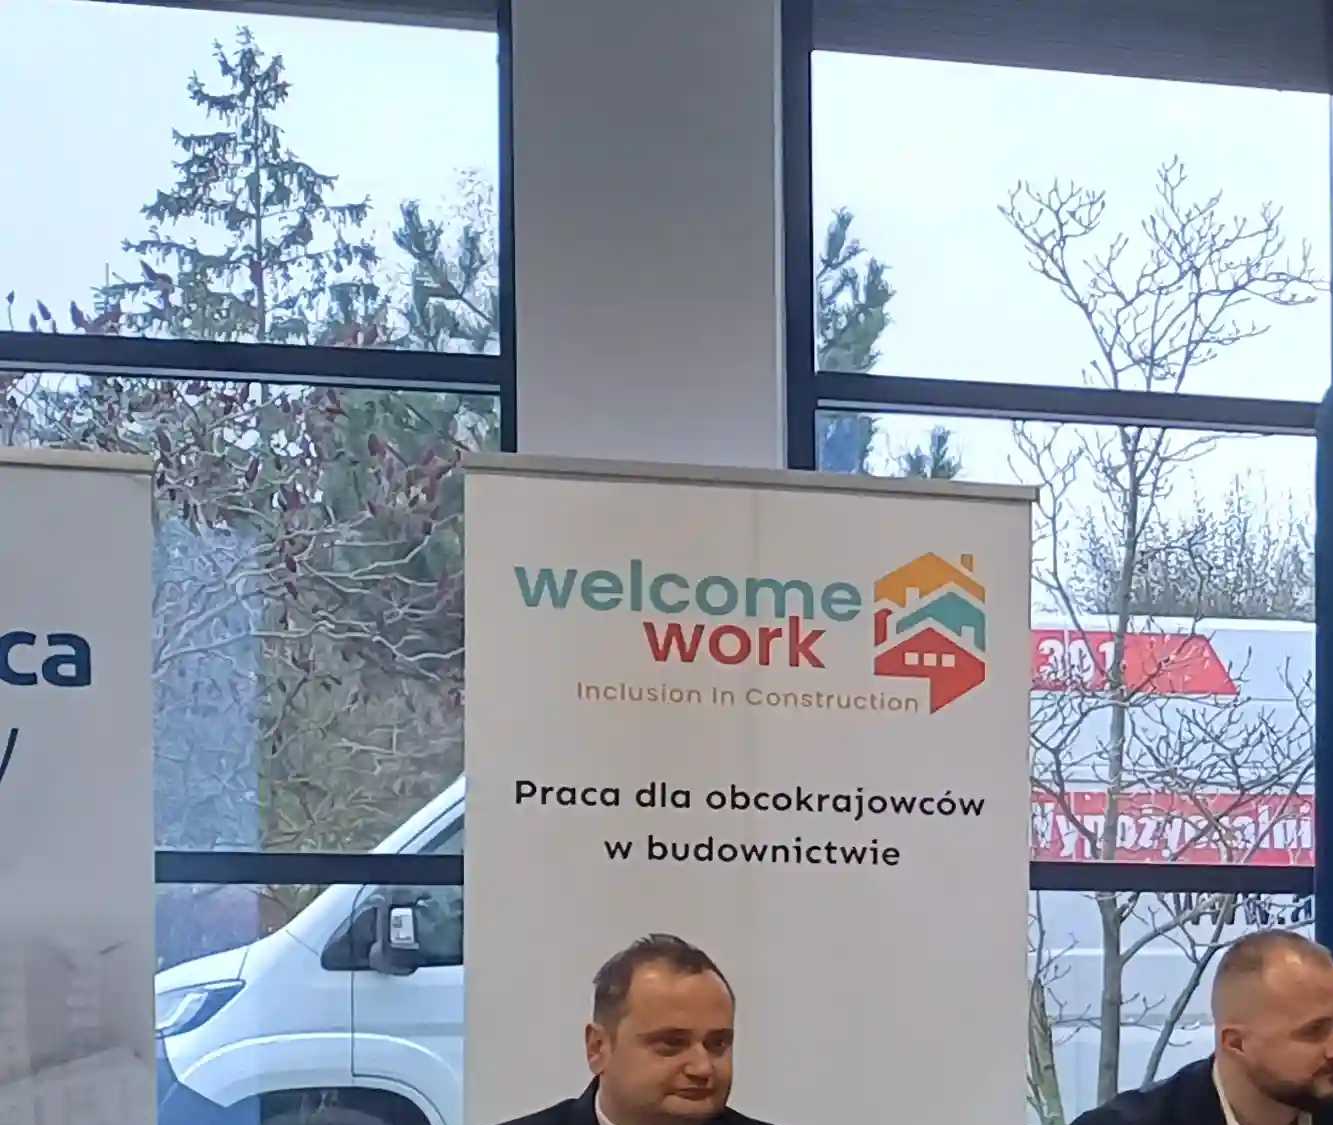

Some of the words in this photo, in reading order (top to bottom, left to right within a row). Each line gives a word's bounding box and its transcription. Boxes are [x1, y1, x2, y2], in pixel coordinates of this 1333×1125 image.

[514, 559, 861, 623] welcome
[643, 617, 826, 669] work
[576, 681, 703, 705] Inclusion
[710, 685, 735, 707] In
[744, 688, 920, 714] Construction
[515, 778, 621, 809] Praca
[636, 781, 693, 810] dla
[705, 782, 984, 820] obcokrajowców
[604, 840, 632, 861] w
[647, 836, 901, 866] budownictwie
